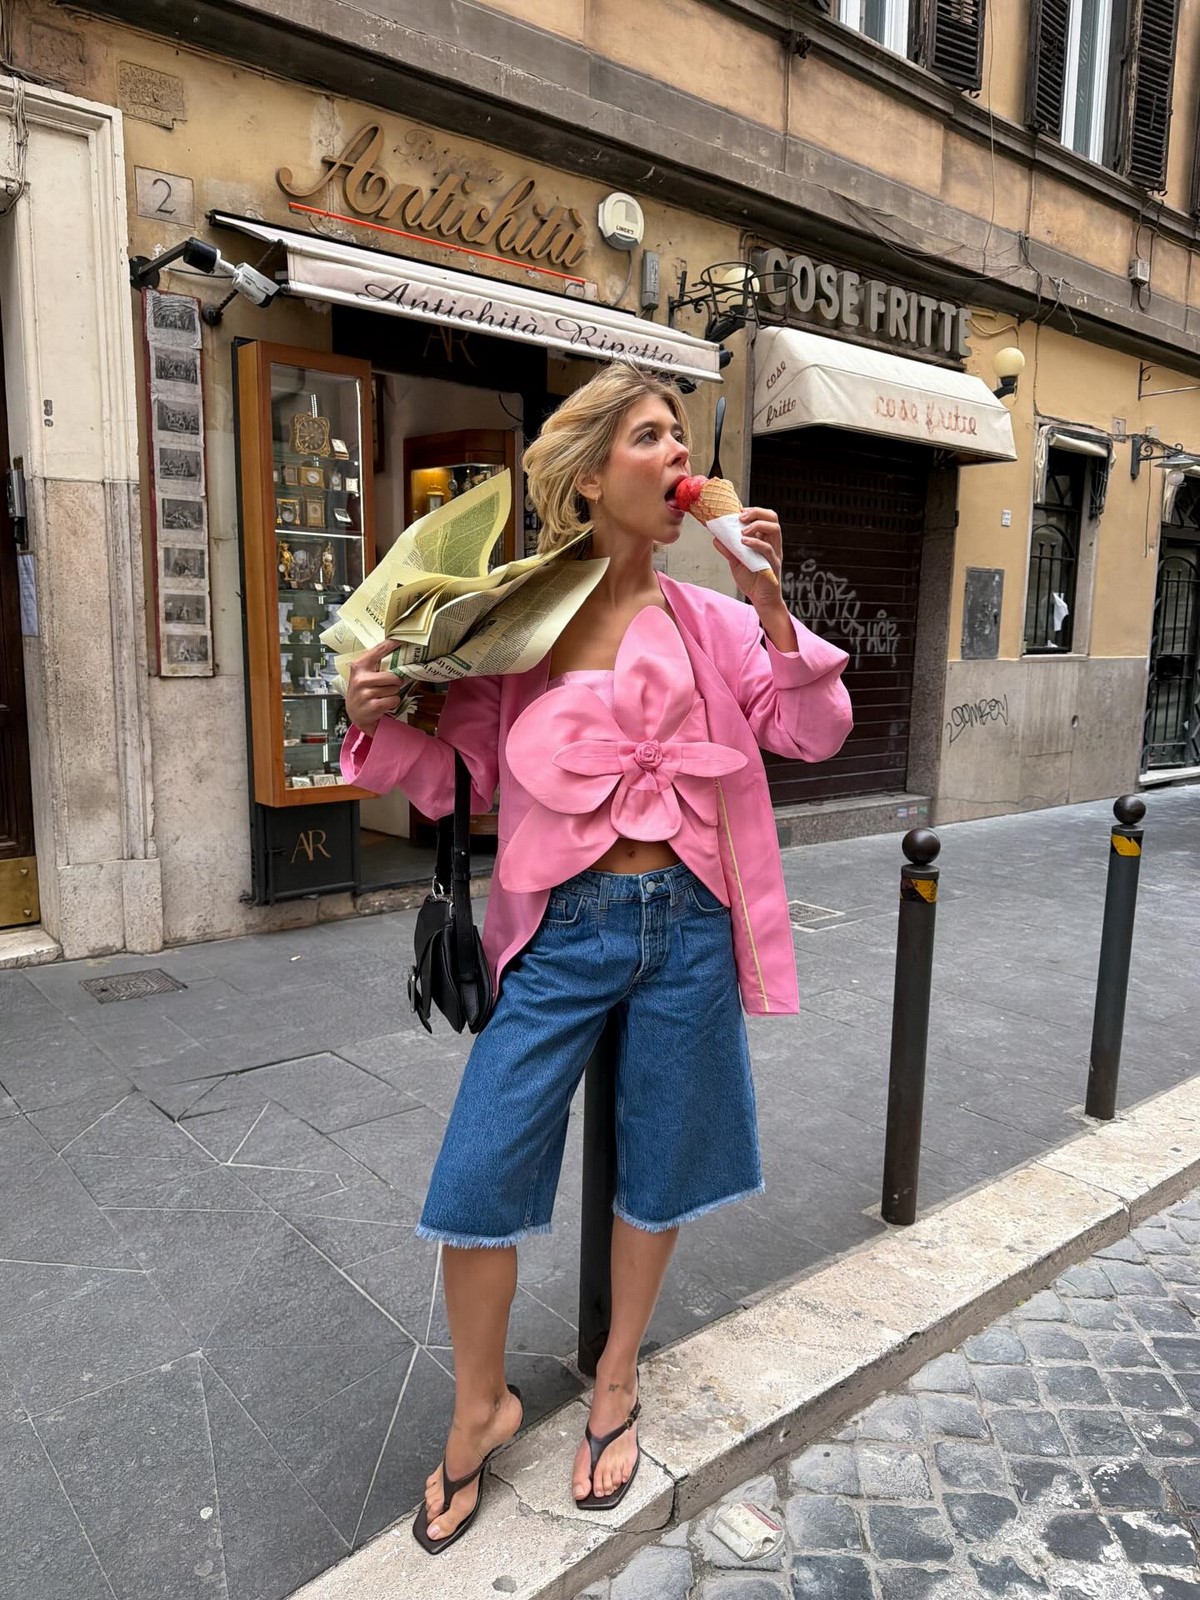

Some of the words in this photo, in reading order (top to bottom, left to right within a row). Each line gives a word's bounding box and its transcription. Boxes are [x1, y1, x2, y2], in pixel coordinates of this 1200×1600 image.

[152, 178, 176, 214] 2
[275, 123, 588, 269] Antichità
[355, 282, 546, 338] Antichità
[762, 247, 861, 326] COSE
[865, 279, 973, 358] FRITTE
[290, 829, 331, 864] AR
